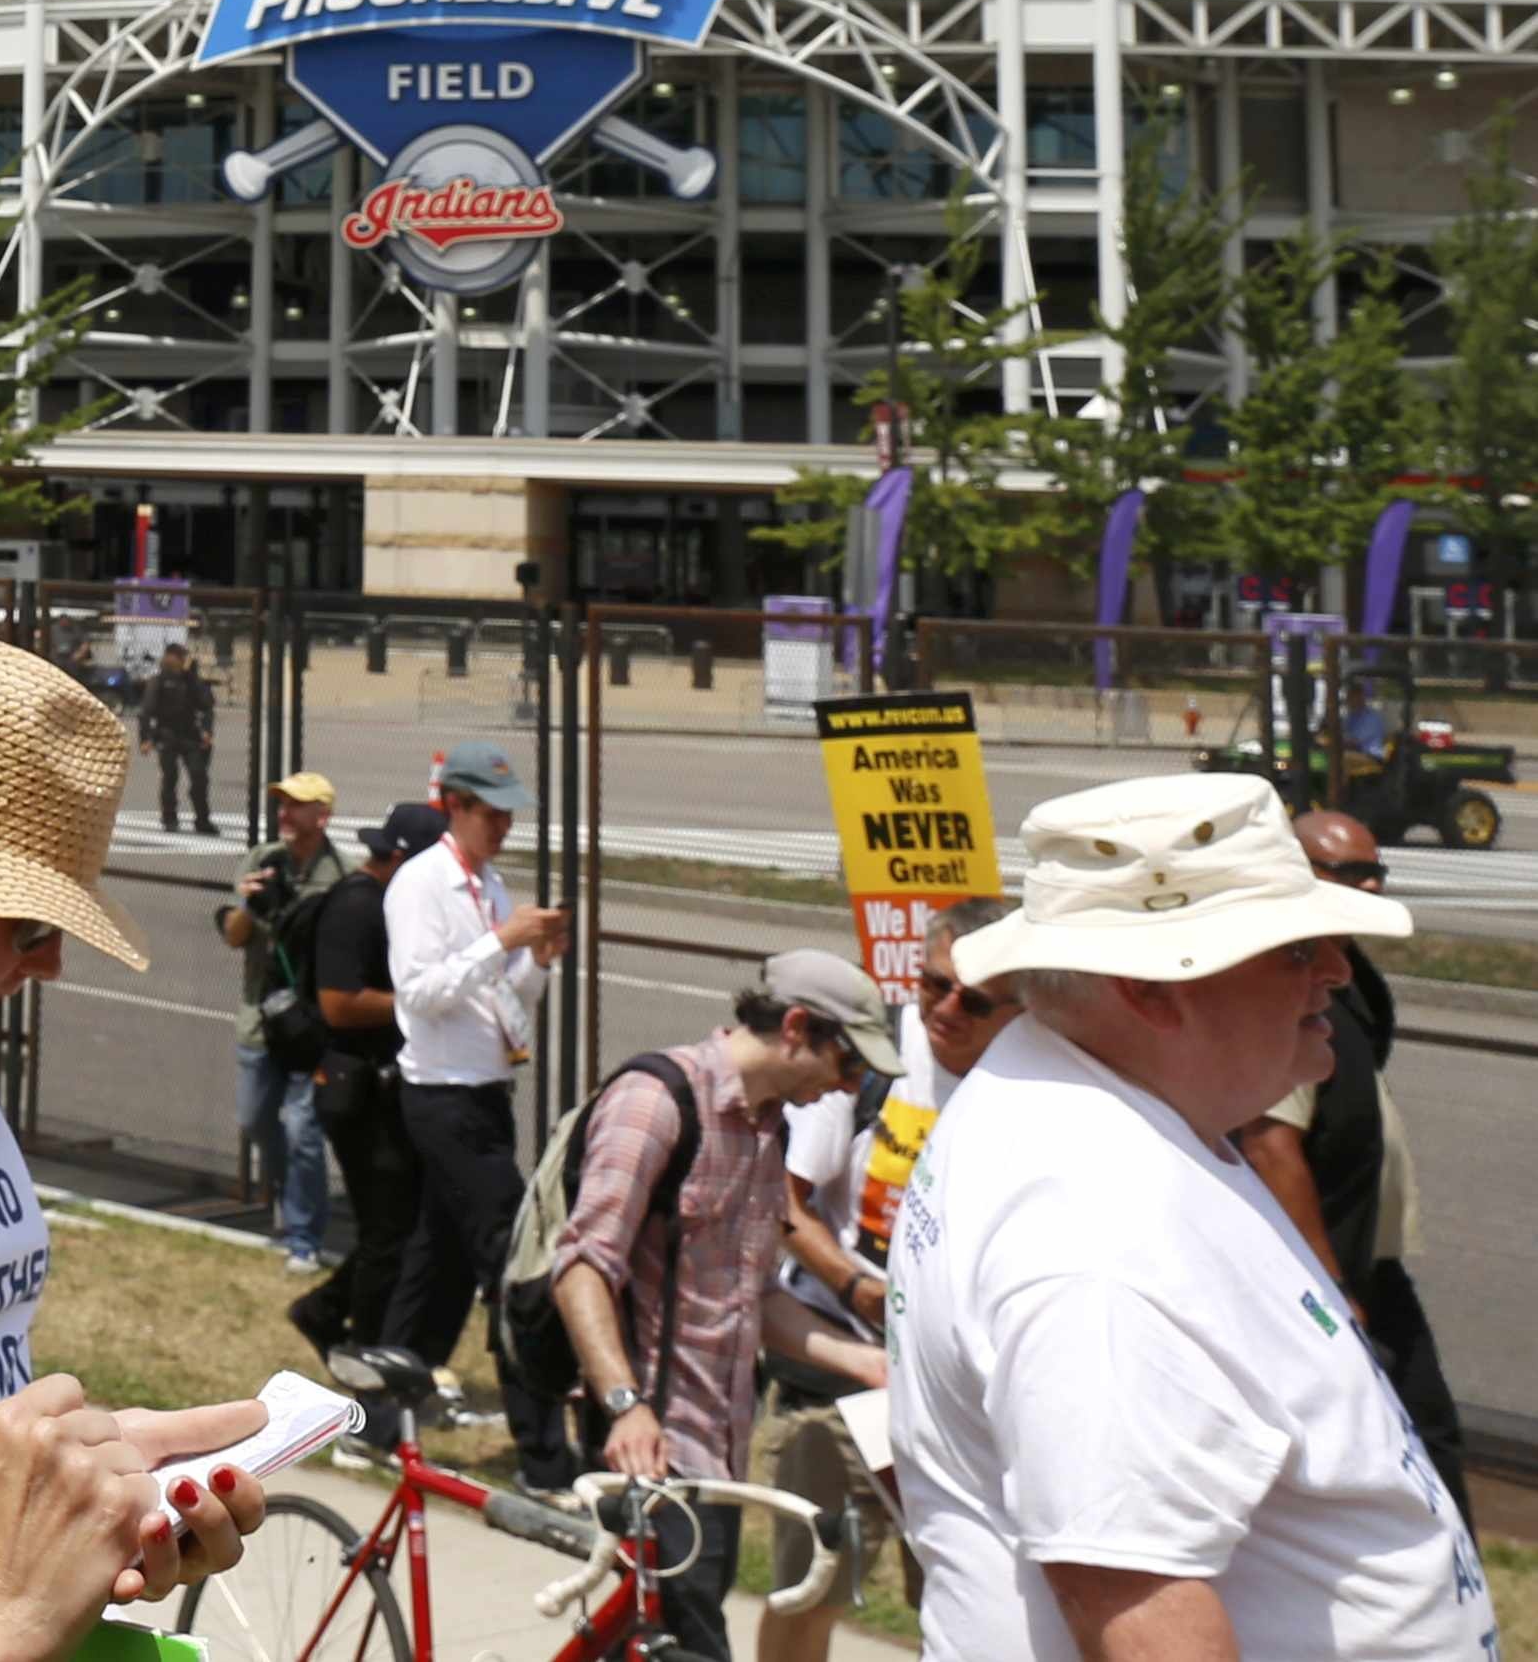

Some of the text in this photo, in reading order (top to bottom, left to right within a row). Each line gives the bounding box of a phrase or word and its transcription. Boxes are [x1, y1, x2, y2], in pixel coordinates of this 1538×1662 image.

[387, 62, 535, 101] FIELD
[341, 176, 564, 255] Indians
[852, 740, 959, 772] America
[890, 778, 940, 804] Was
[862, 812, 974, 851] NEVER
[887, 857, 968, 885] Great!
[863, 899, 907, 938] We
[874, 941, 924, 978] OVE
